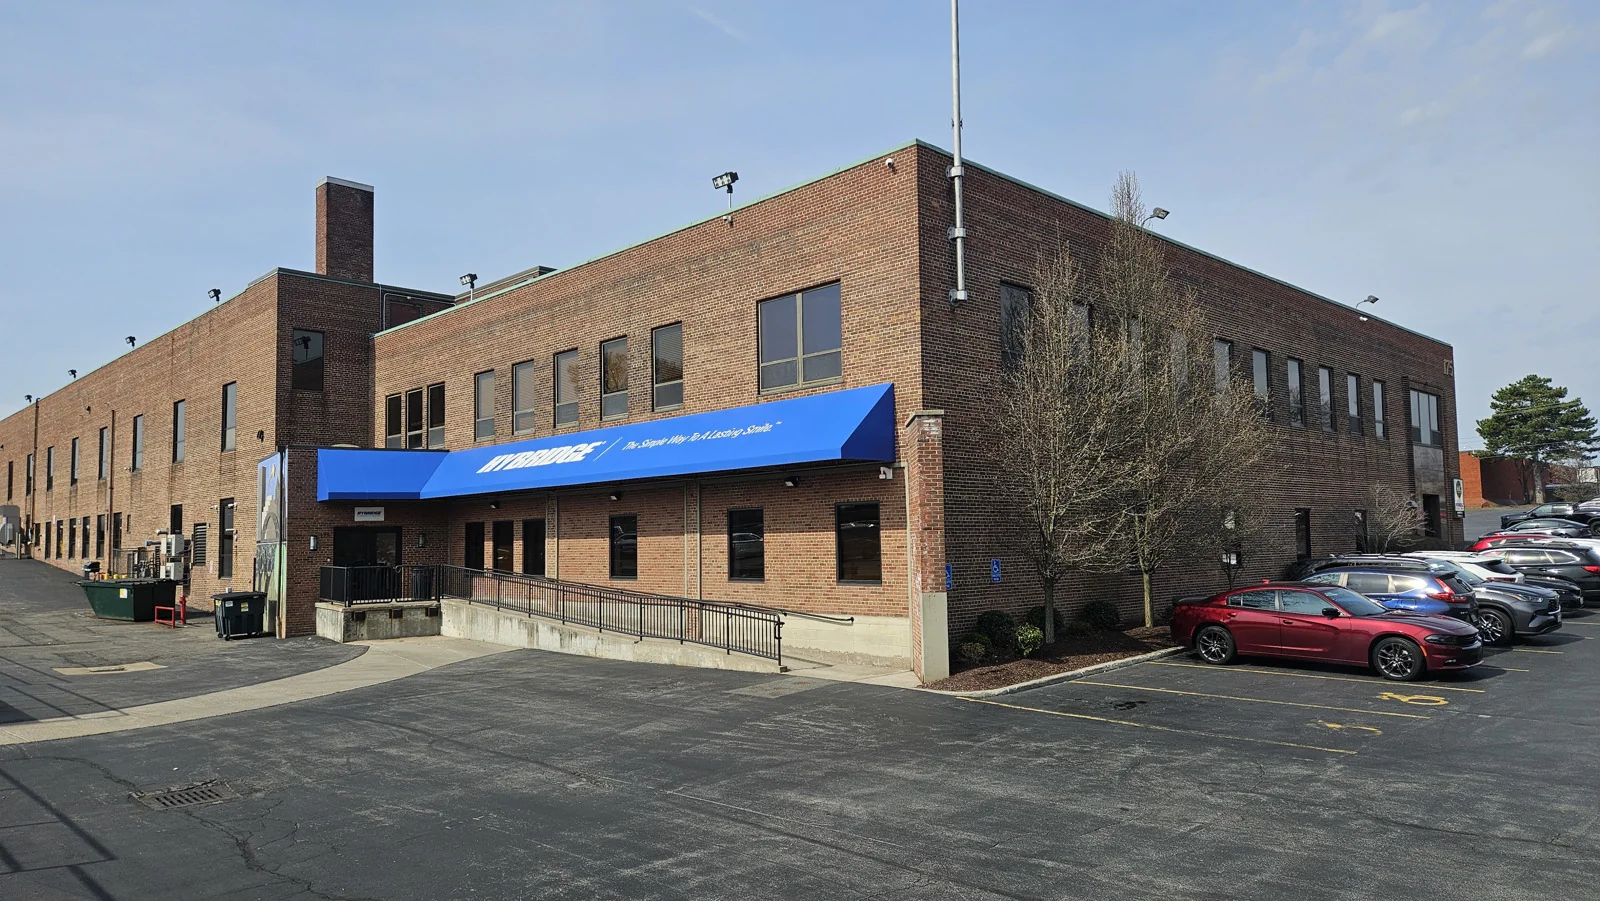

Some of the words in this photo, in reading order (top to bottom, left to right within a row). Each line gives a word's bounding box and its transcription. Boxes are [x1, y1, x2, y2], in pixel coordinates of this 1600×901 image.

[621, 441, 639, 451] The
[638, 437, 668, 449] Simple
[666, 434, 690, 446] Way
[687, 432, 700, 442] To
[698, 430, 710, 441] A
[707, 428, 743, 439] Lasting
[476, 441, 603, 473] HYBRIDGE
